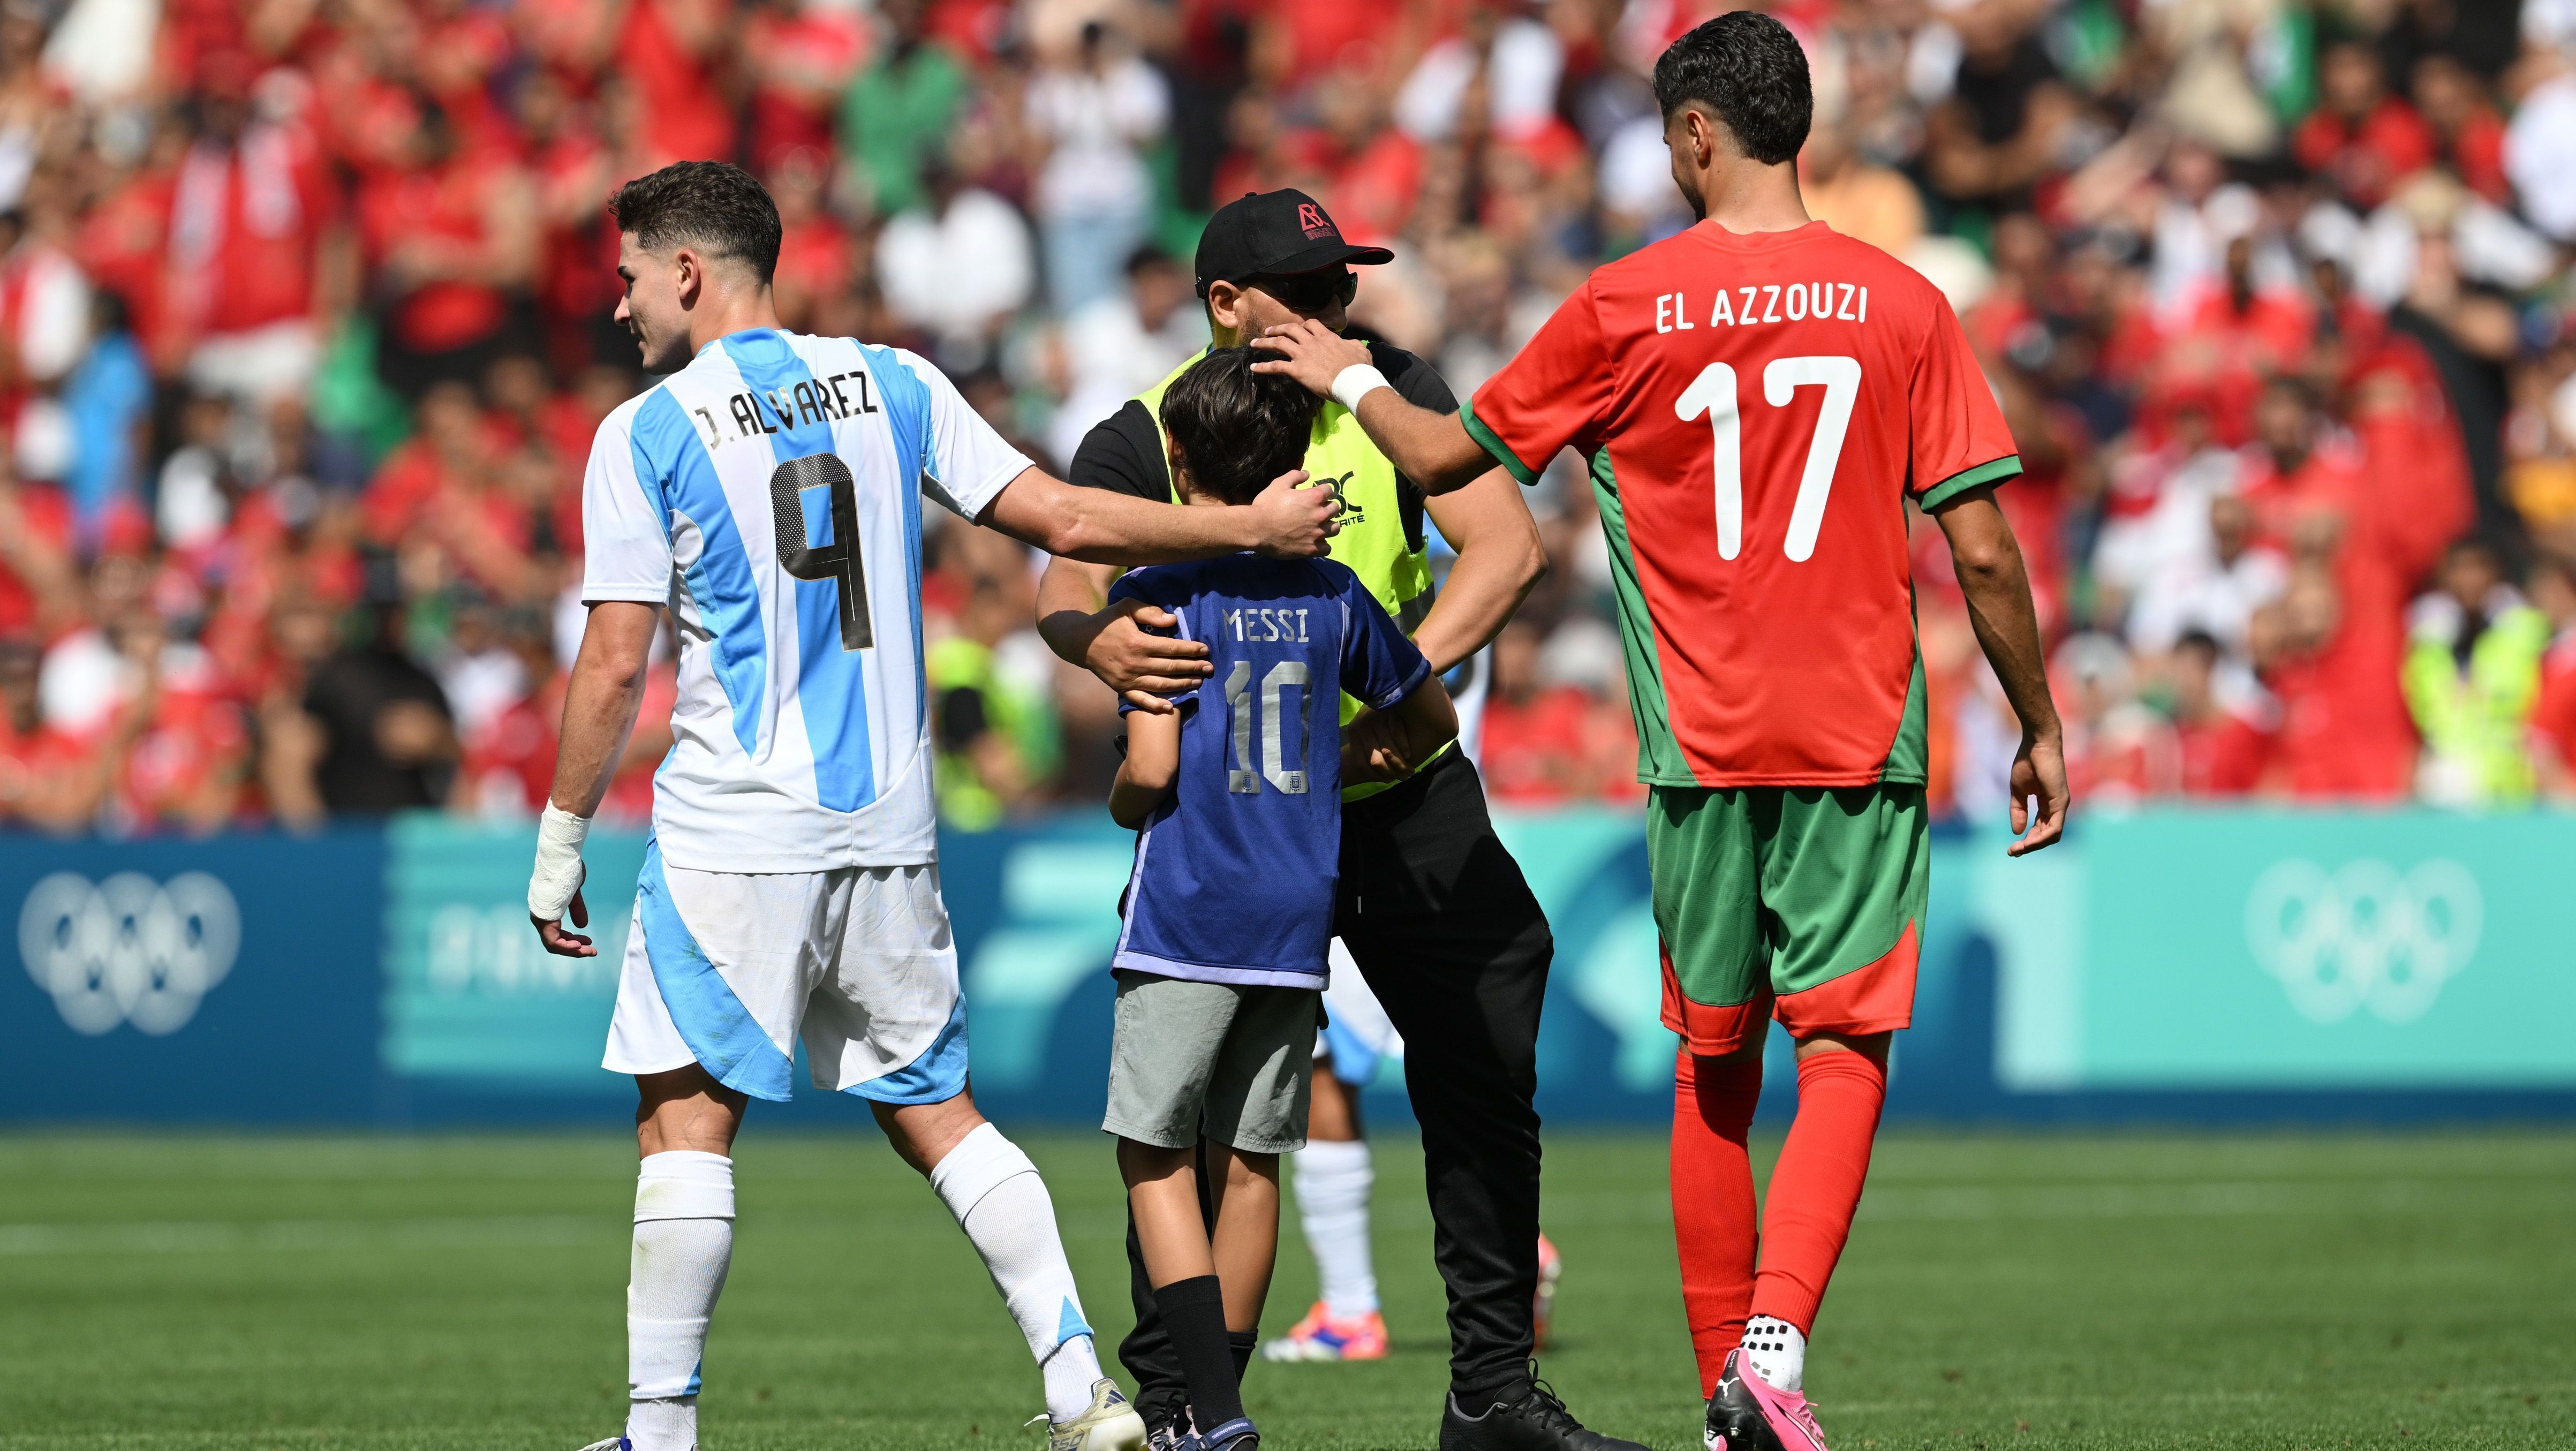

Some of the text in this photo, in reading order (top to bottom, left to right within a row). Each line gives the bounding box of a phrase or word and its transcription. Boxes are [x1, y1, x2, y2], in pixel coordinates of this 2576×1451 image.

[1656, 282, 1867, 334] EL AZZOUZI
[1675, 356, 1862, 562] 17
[769, 452, 874, 652] 9
[1222, 608, 1310, 643] MESSI
[1225, 661, 1313, 794] 10
